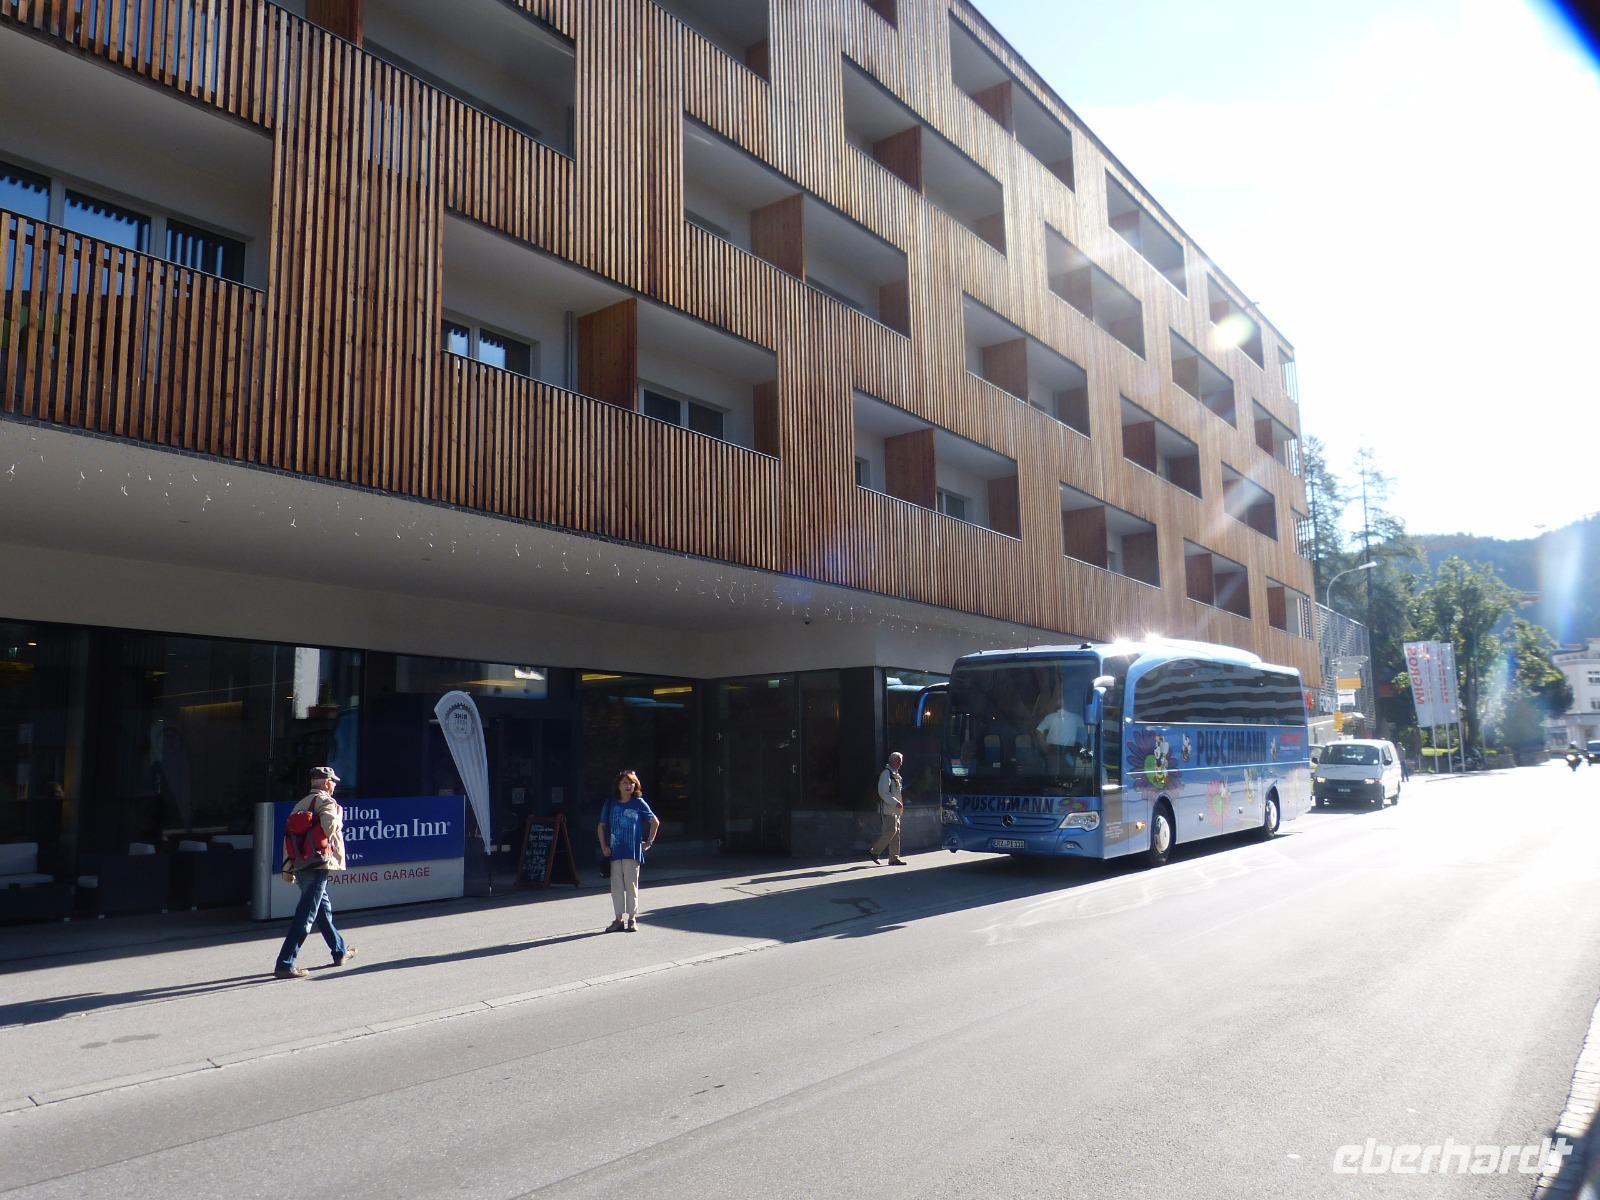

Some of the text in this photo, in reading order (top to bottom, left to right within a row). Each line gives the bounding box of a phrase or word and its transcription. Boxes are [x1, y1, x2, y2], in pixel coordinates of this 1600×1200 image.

[1197, 730, 1267, 766] PUSCHMANN
[342, 806, 380, 820] ilton
[962, 796, 1054, 813] PUSCHMANN
[341, 820, 409, 841] arden
[327, 866, 430, 885] PARKING GARAGE
